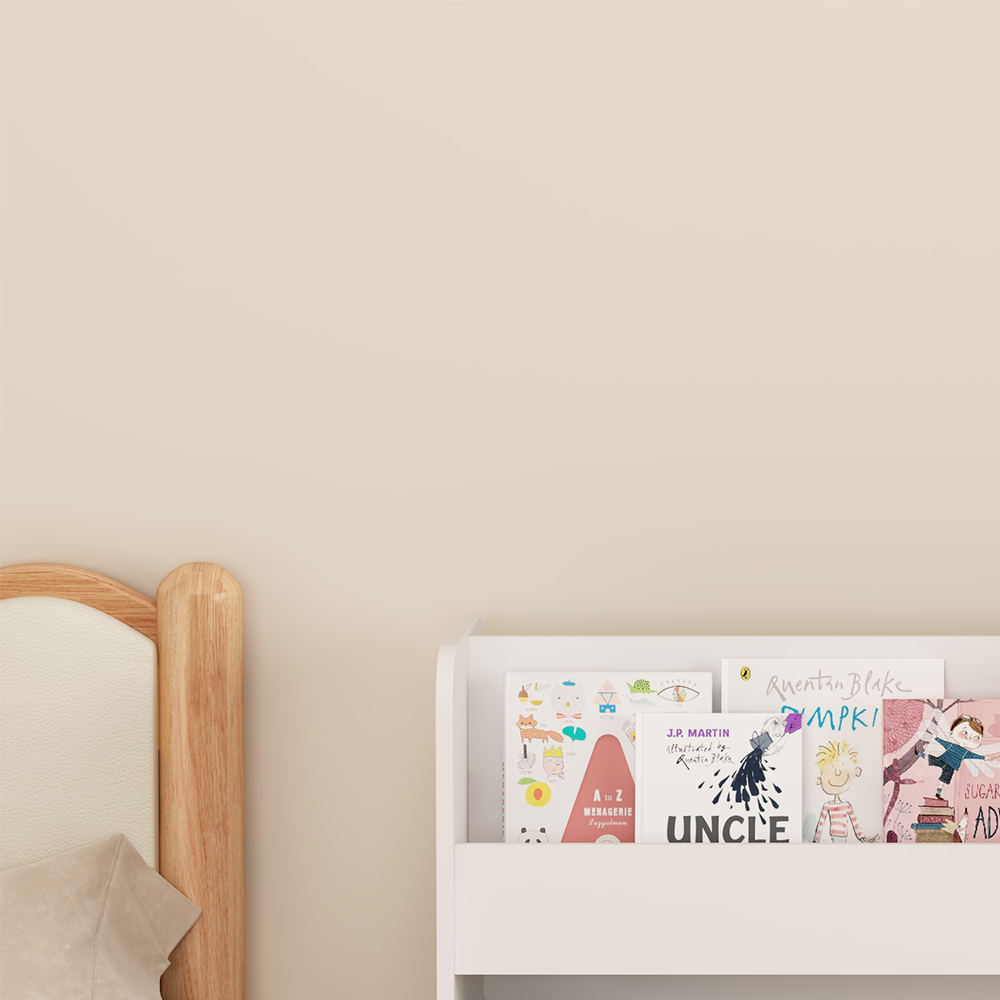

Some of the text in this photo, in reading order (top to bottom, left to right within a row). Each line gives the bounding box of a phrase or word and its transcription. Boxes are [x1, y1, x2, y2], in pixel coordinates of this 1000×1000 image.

[765, 669, 913, 702] Quentin Blake
[666, 728, 730, 738] J.P. MARTIN
[593, 789, 601, 802] A
[615, 789, 623, 802] Z
[583, 807, 633, 817] MENAGERIE
[667, 815, 790, 843] UNCLE
